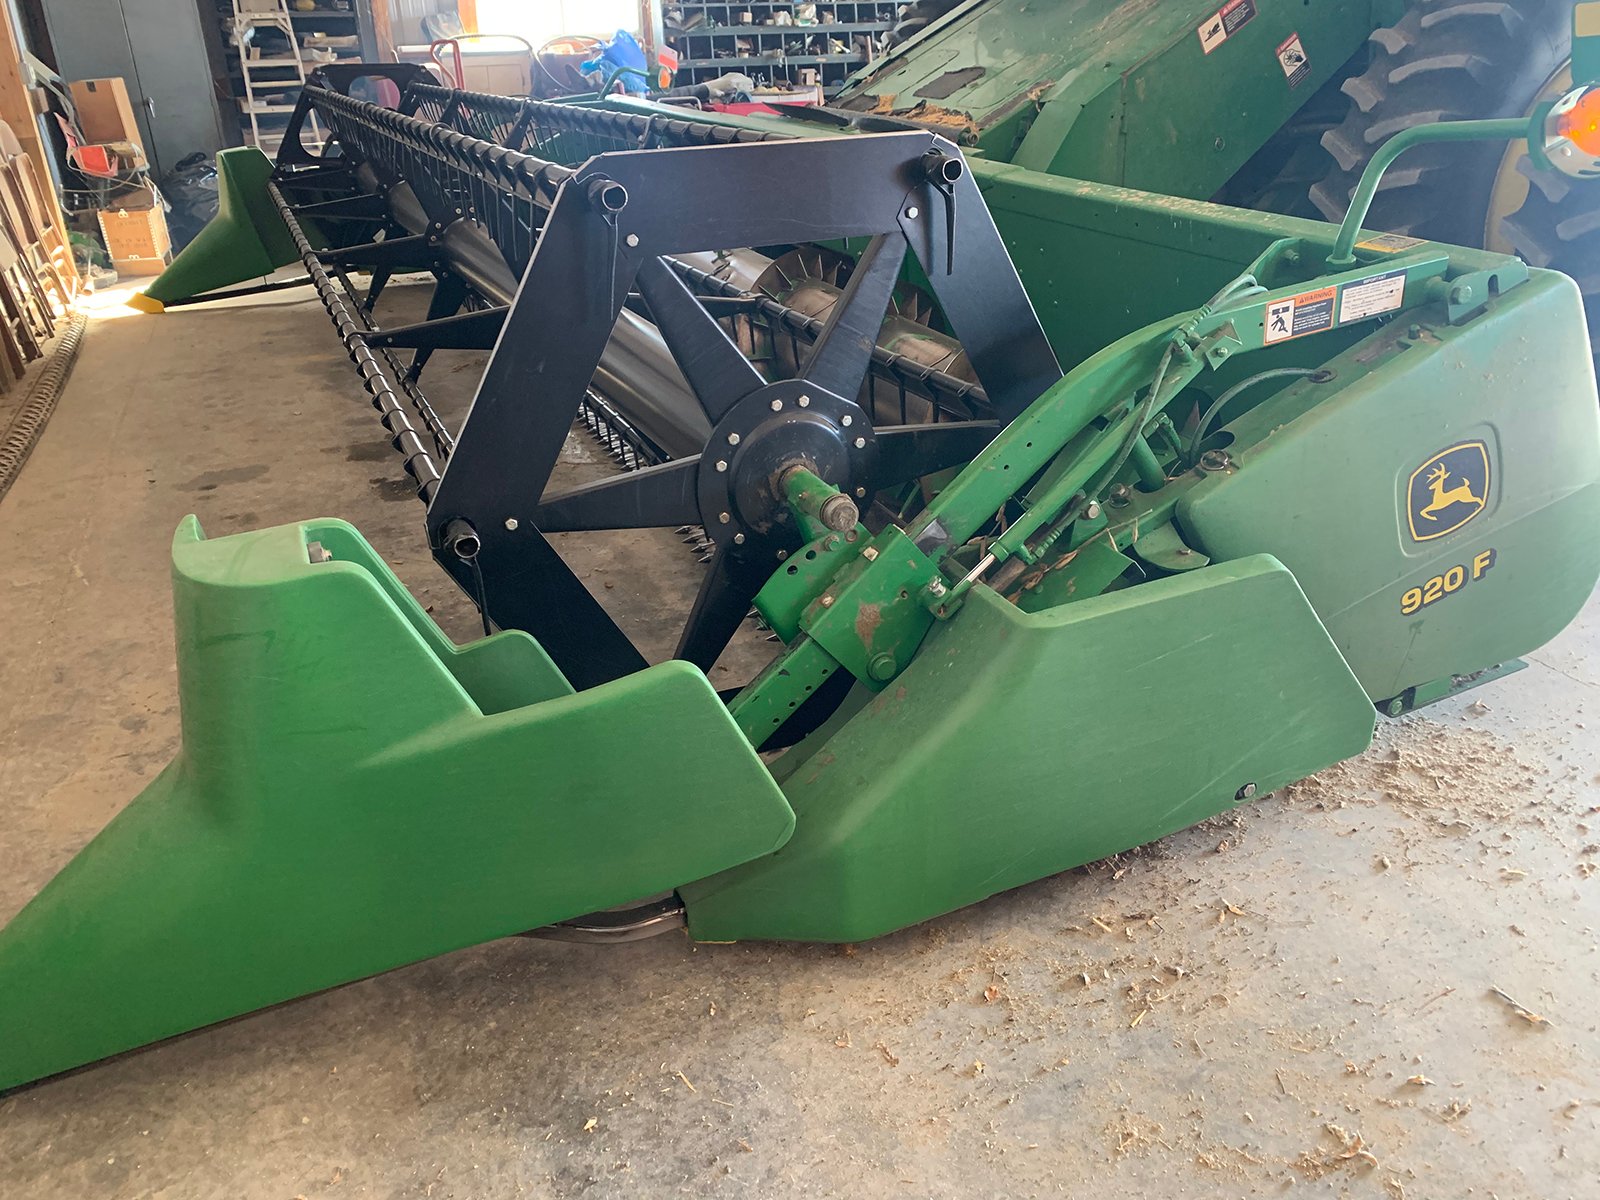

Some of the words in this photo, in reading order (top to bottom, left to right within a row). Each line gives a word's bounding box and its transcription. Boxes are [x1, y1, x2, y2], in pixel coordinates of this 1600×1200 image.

[1304, 290, 1333, 302] WARNING
[1400, 564, 1468, 616] 920
[1473, 548, 1496, 581] F
